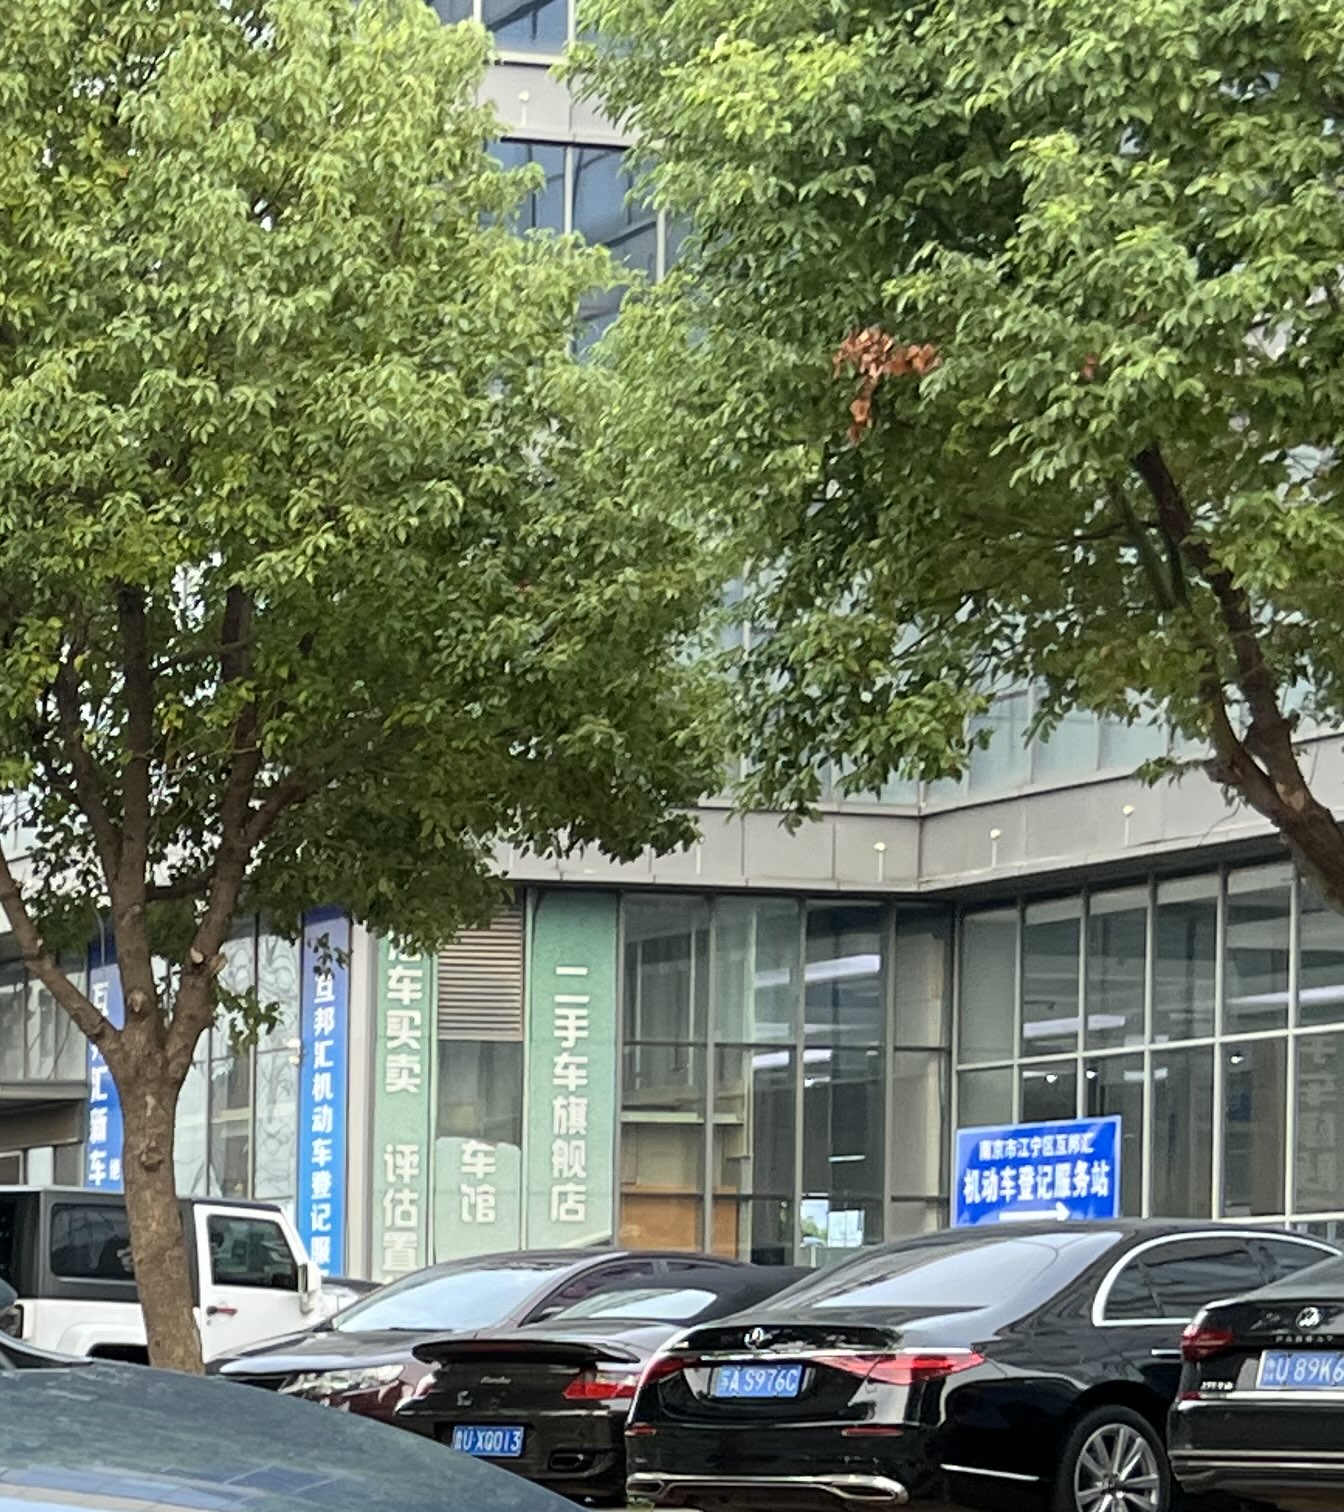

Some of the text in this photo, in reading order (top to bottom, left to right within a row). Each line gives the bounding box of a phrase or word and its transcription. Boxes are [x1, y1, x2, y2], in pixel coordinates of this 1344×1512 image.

[89, 981, 109, 1187] 互汇新车
[310, 973, 335, 1276] 互邦汇机动车登记服
[550, 966, 589, 1222] 二手车旗舰店
[383, 1143, 419, 1284] 评估置
[460, 1141, 496, 1224] 车馆
[963, 1160, 1110, 1204] 机动车登记服务站
